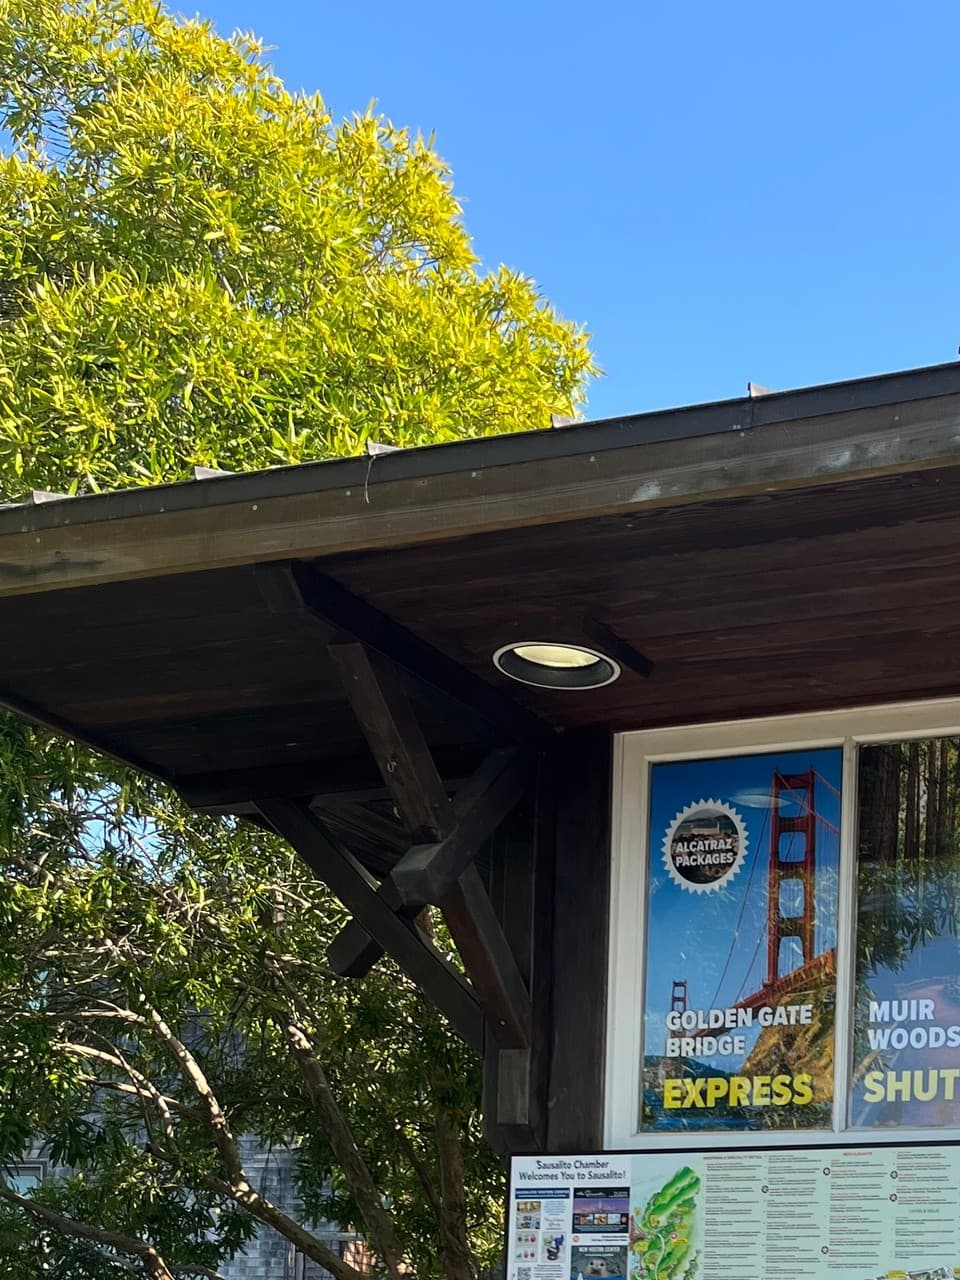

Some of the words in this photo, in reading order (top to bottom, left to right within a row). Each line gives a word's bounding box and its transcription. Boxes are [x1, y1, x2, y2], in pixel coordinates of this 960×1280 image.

[675, 838, 733, 853] ALCATRAZ
[675, 852, 735, 867] PACKAGES
[666, 1006, 754, 1032] GOLDEN
[758, 1004, 813, 1028] GATE
[869, 999, 936, 1024] MUIR
[665, 1035, 746, 1058] BRIDGE
[663, 1072, 814, 1110] EXPRESS
[536, 1160, 572, 1170] Sausalito
[574, 1160, 610, 1169] Chamber
[519, 1171, 558, 1181] Welcomes
[560, 1171, 575, 1180] You
[578, 1172, 586, 1180] to
[588, 1170, 626, 1180] Sausalito!
